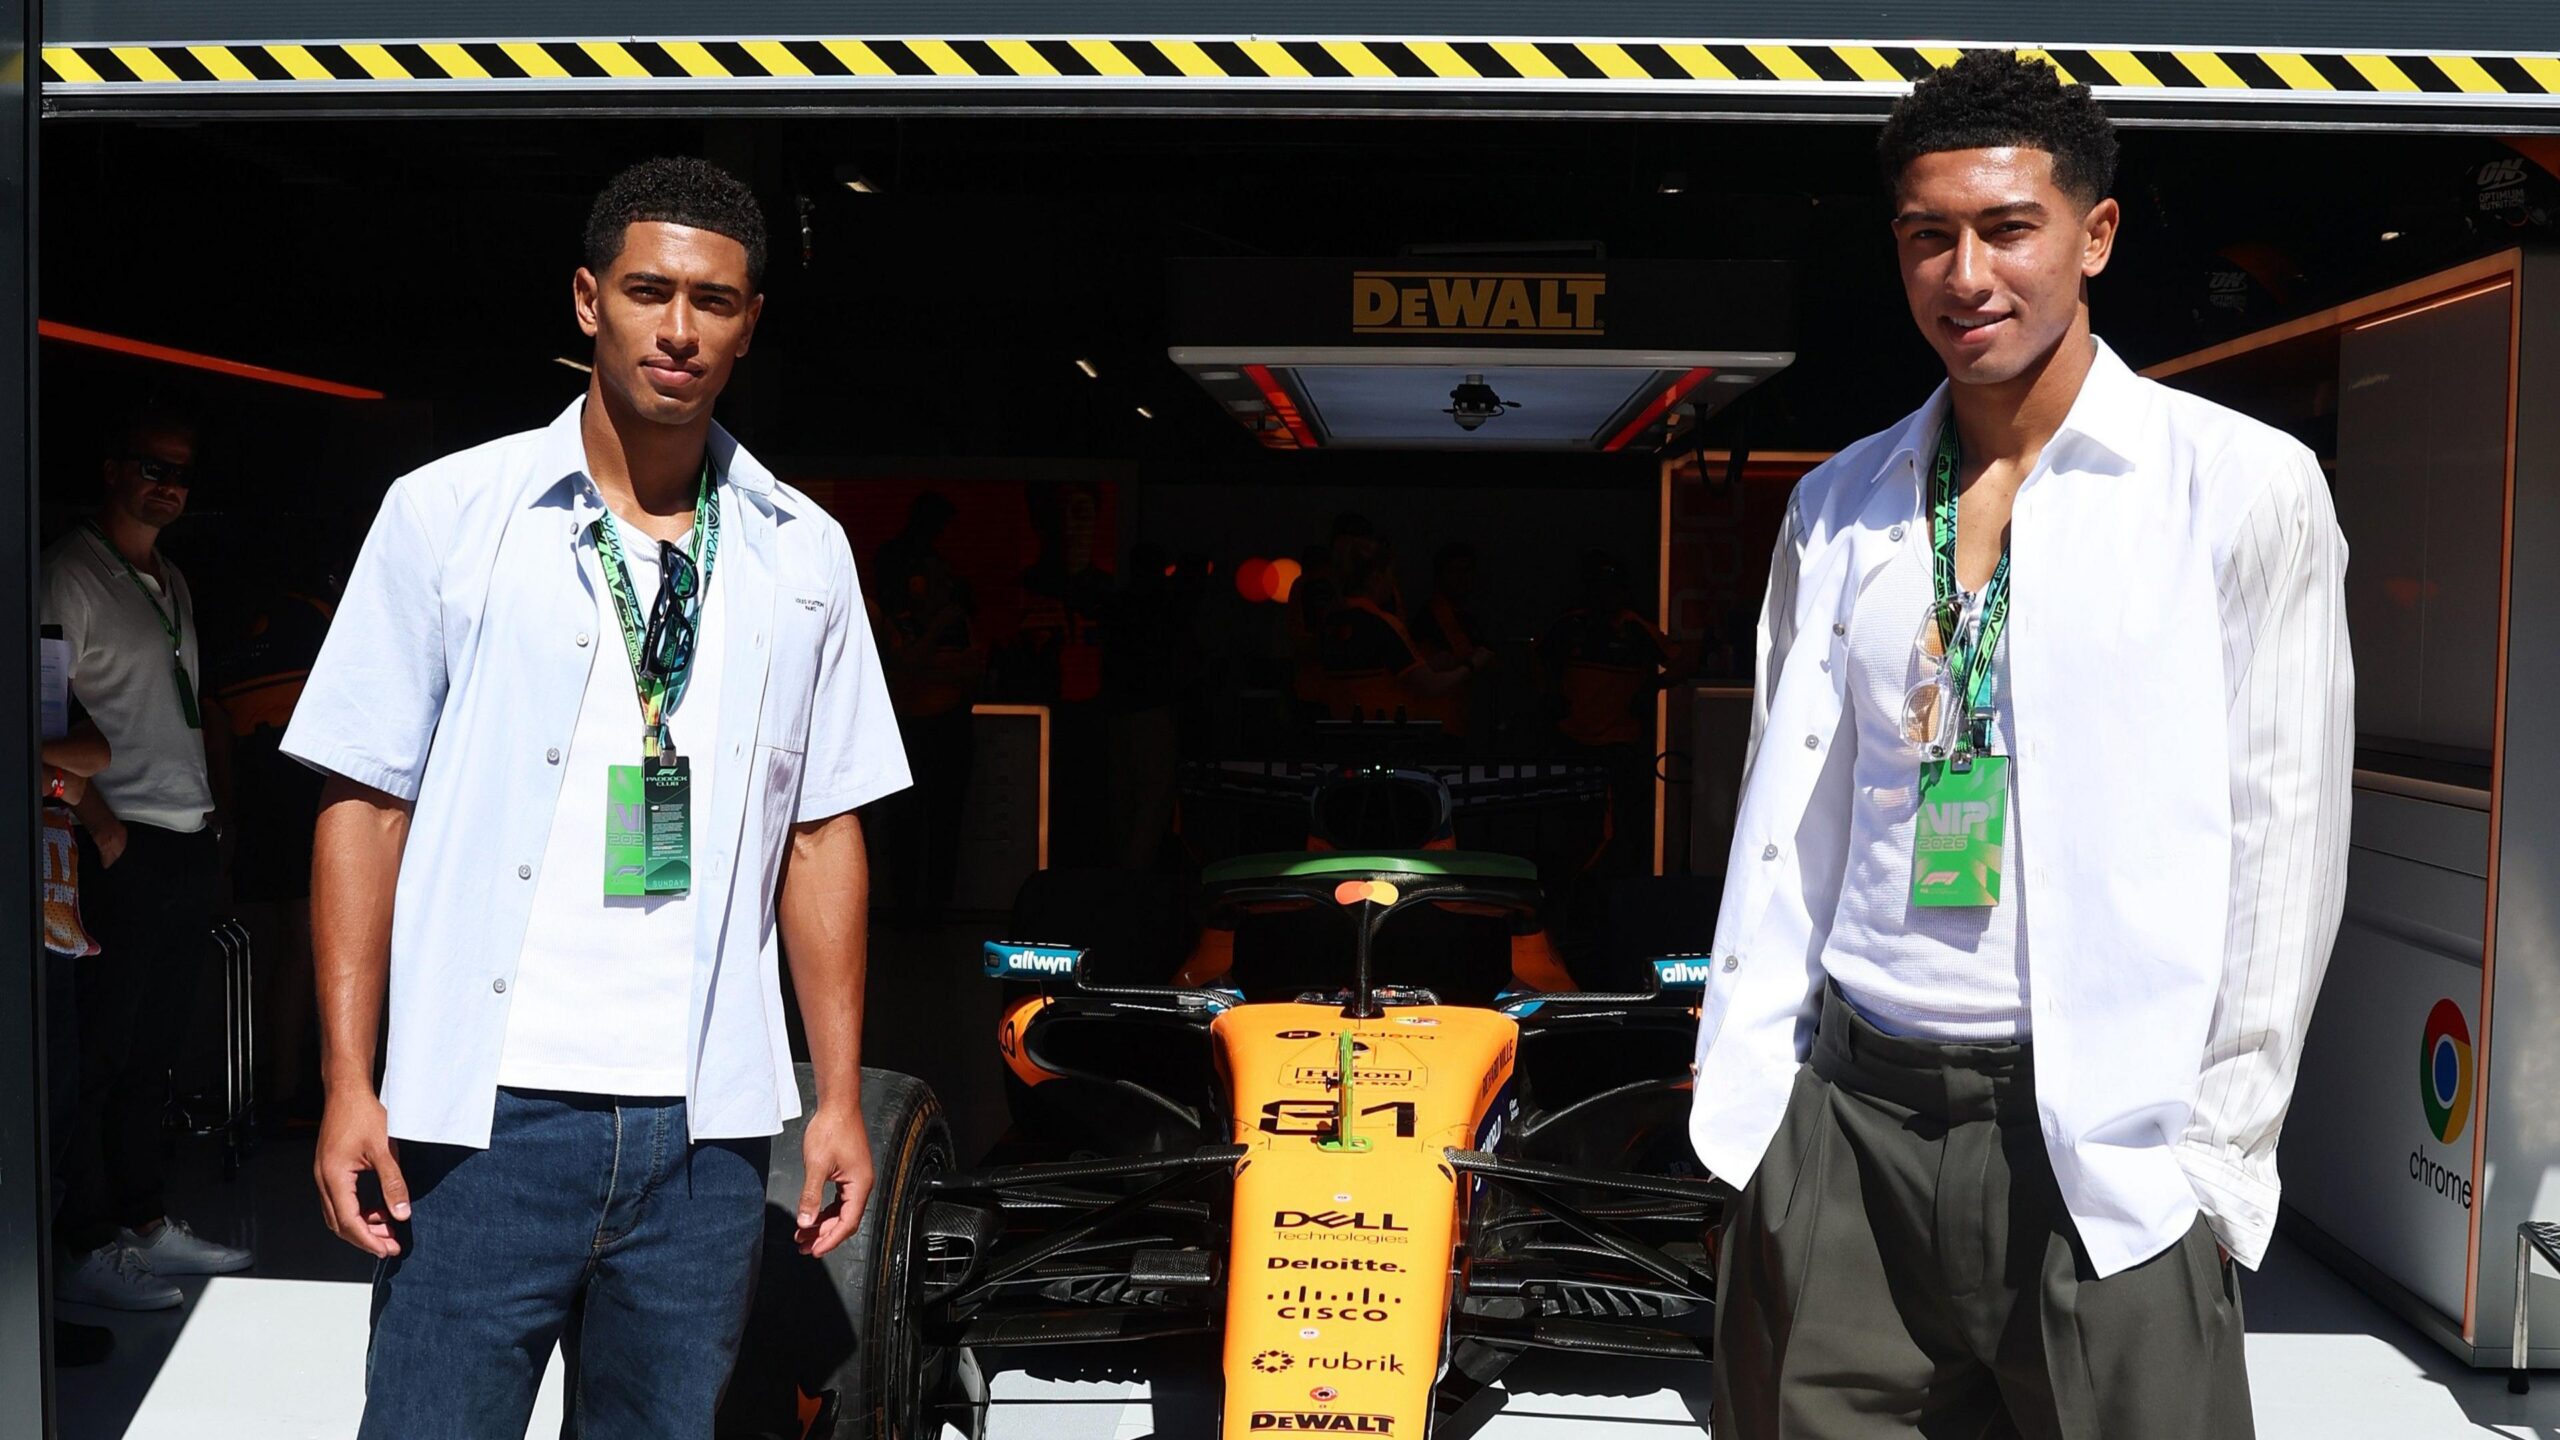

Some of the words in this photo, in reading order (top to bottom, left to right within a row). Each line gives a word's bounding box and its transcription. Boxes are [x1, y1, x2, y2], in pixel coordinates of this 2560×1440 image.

[1926, 801, 1990, 835] VIP
[608, 833, 644, 846] 202
[1919, 837, 1967, 850] 2026
[653, 879, 684, 888] SUNDAY
[1008, 950, 1072, 975] allwyn
[1662, 963, 1709, 983] allw
[1306, 1069, 1402, 1079] Hiton
[2409, 1144, 2472, 1210] chrome
[1273, 1210, 1409, 1231] DELL
[1273, 1230, 1409, 1244] Technologies
[1267, 1257, 1407, 1273] Deloitte.
[1308, 1351, 1405, 1376] rubrik
